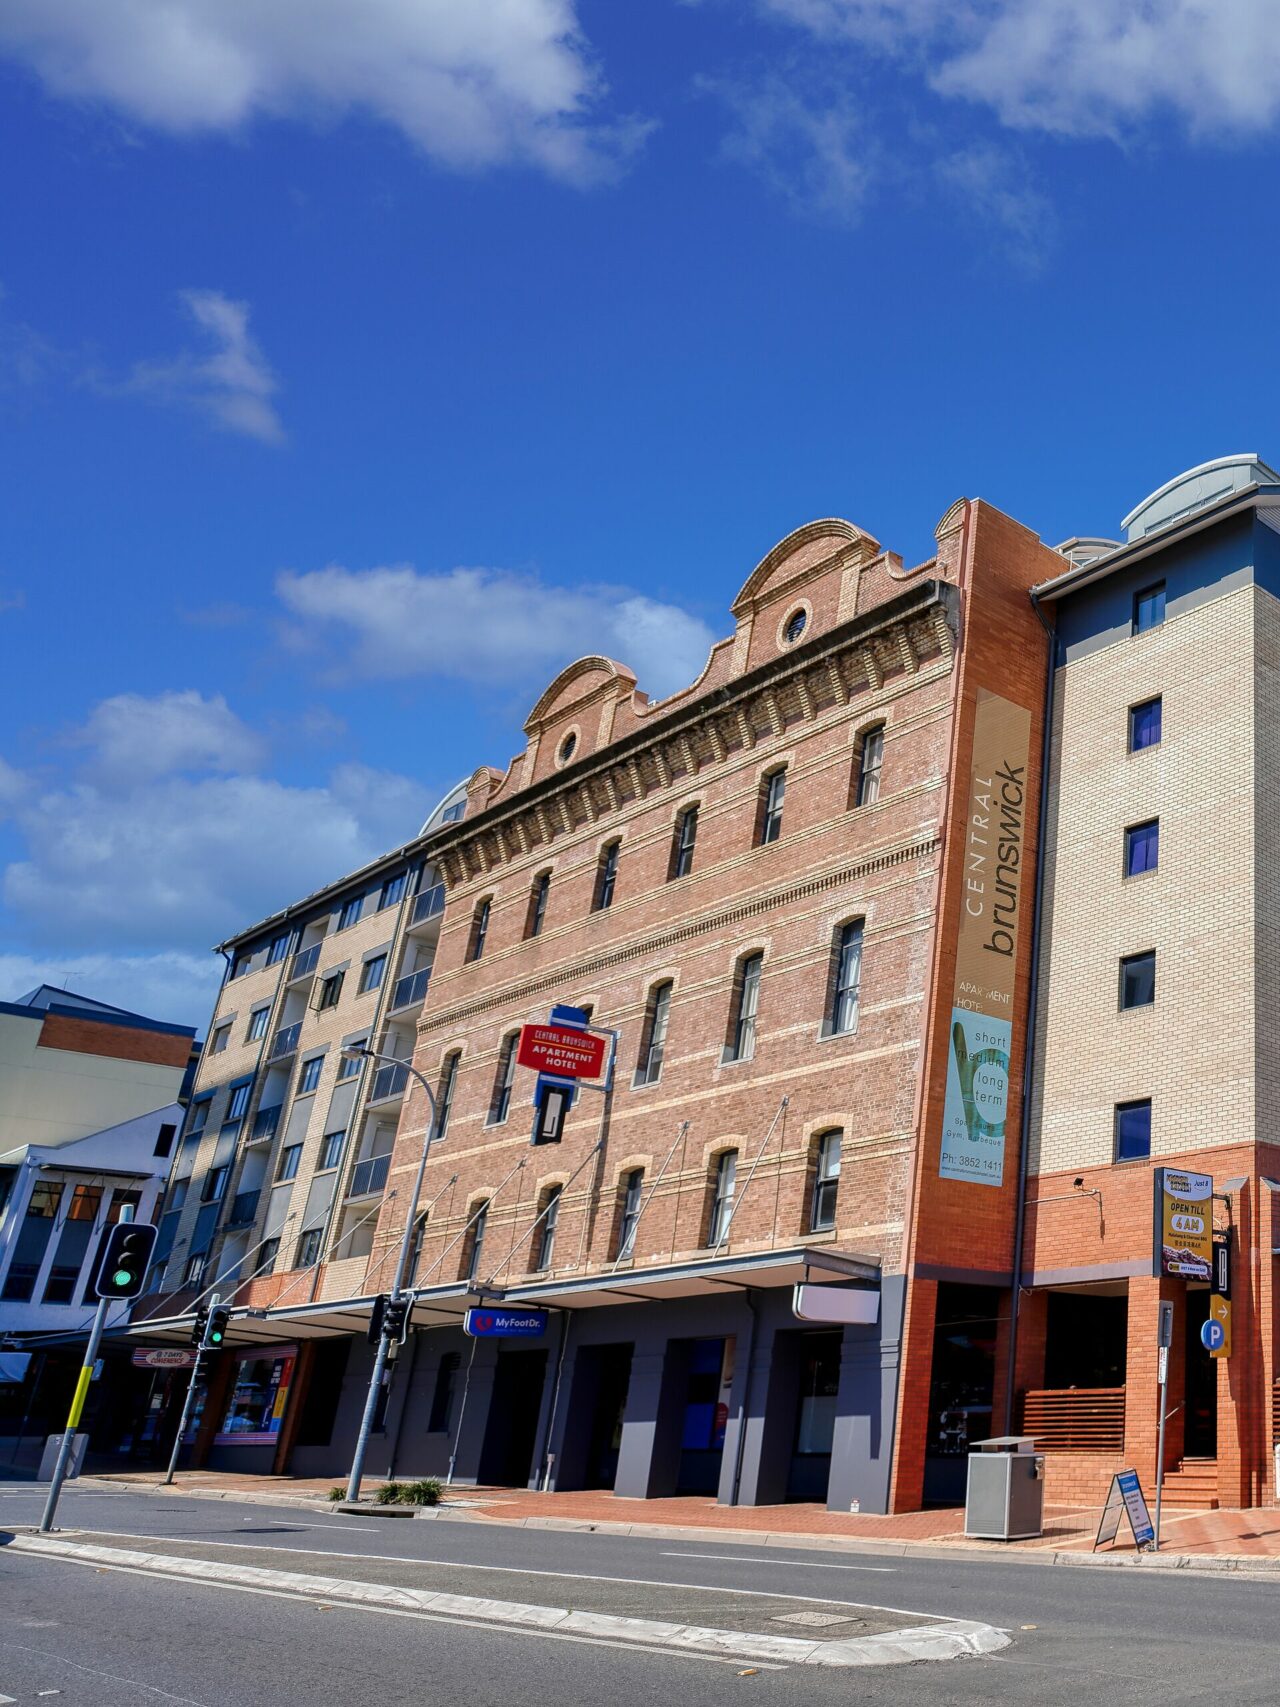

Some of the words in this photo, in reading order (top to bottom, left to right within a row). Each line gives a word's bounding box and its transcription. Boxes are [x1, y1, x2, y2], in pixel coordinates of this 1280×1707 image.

[966, 777, 992, 917] CENTRAL
[983, 760, 1025, 957] brunswick
[959, 981, 1011, 1005] APARMENT
[956, 997, 983, 1013] HOTE
[535, 1030, 560, 1043] CENTRAL
[562, 1034, 595, 1049] BRUNSWICK
[975, 1032, 1006, 1048] short
[532, 1045, 593, 1063] APARTMENT
[545, 1057, 577, 1070] HOTEL
[957, 1049, 1005, 1068] medium
[978, 1071, 1004, 1090] long
[975, 1090, 1002, 1106] term
[942, 1152, 957, 1164] Ph:
[959, 1155, 981, 1168] 3852
[983, 1160, 1002, 1172] 1411
[1170, 1203, 1189, 1213] OPEN
[1191, 1205, 1205, 1215] TILL
[1176, 1216, 1182, 1229] 4
[1184, 1218, 1199, 1231] AM
[1211, 1326, 1221, 1346] P
